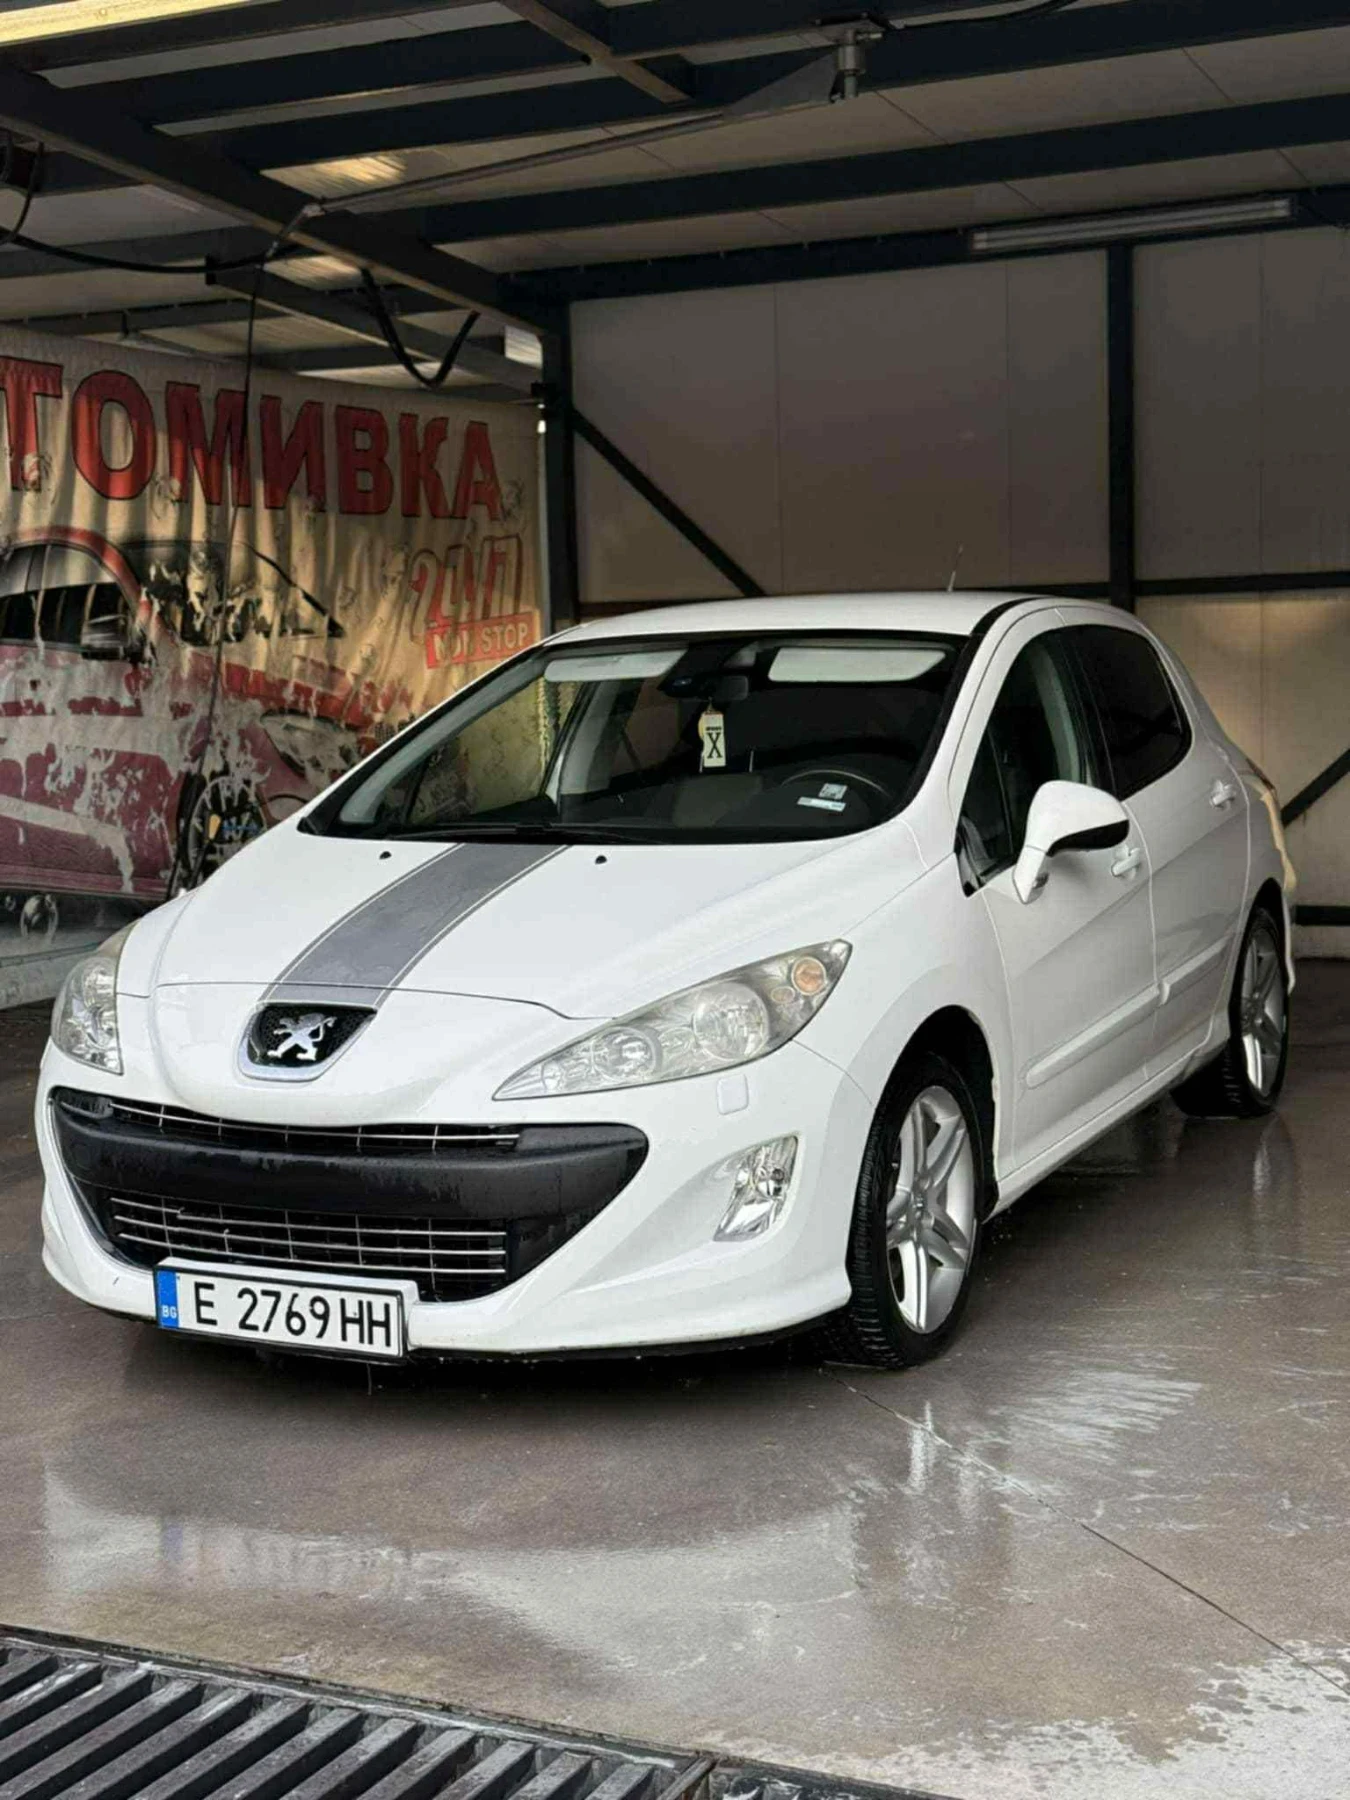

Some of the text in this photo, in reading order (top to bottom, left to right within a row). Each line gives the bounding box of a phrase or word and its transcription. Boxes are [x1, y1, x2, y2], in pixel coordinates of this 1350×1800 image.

[481, 622, 528, 653] STOP
[162, 1304, 177, 1319] BG
[194, 1281, 391, 1348] E 2769 HH
